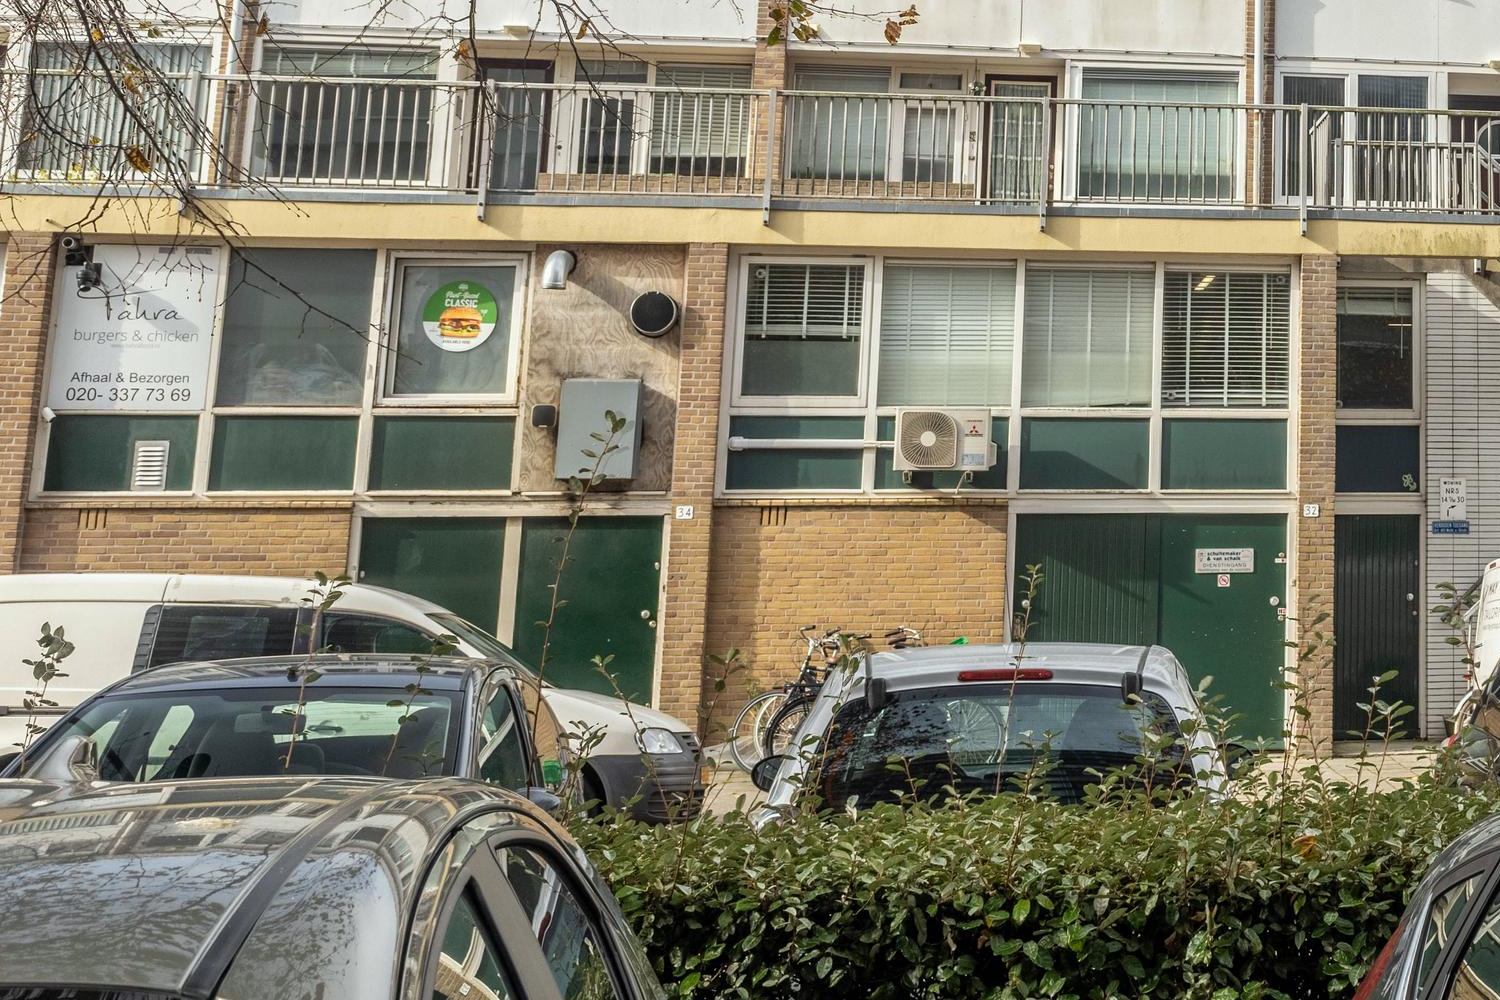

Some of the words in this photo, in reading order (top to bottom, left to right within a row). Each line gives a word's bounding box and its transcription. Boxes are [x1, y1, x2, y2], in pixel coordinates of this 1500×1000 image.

[444, 298, 478, 308] CLASSIC
[74, 329, 127, 344] burgers
[132, 330, 143, 342] &
[147, 330, 199, 343] chicken
[70, 371, 112, 383] Afhaal
[116, 373, 125, 383] &
[129, 373, 190, 386] Bezorgen
[66, 387, 103, 401] 020-
[109, 387, 139, 401] 337
[146, 387, 165, 401] 73
[170, 387, 191, 402] 69
[677, 507, 692, 518] 34
[1304, 505, 1317, 516] 32
